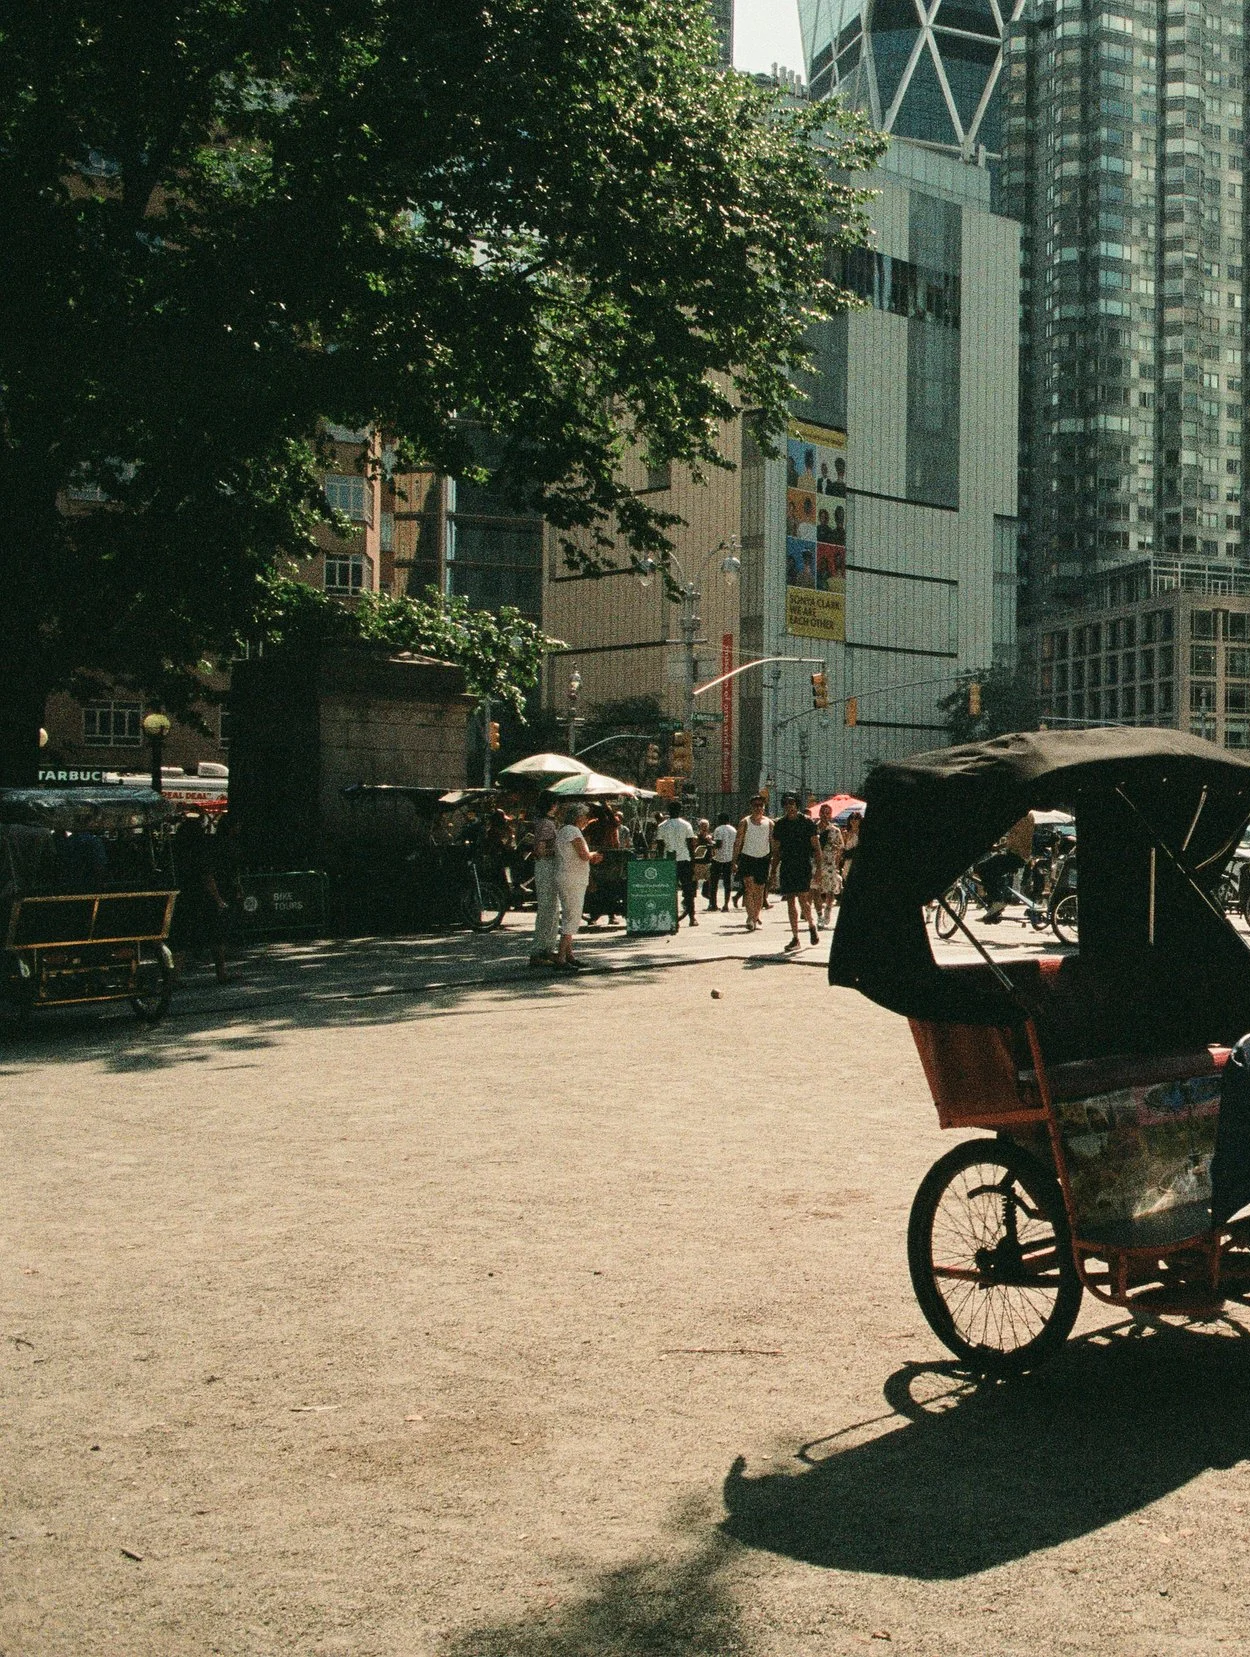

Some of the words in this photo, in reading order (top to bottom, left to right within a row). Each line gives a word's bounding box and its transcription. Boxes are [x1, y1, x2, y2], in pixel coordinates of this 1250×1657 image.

[816, 598, 840, 609] CLARK
[790, 605, 802, 615] WE
[803, 607, 817, 617] ARE
[790, 615, 809, 626] EACH
[810, 618, 834, 630] OTHER
[723, 690, 730, 700] of
[723, 725, 731, 745] and
[38, 770, 101, 781] TARBUC
[273, 892, 293, 901] BIKE
[274, 902, 304, 911] TOURS
